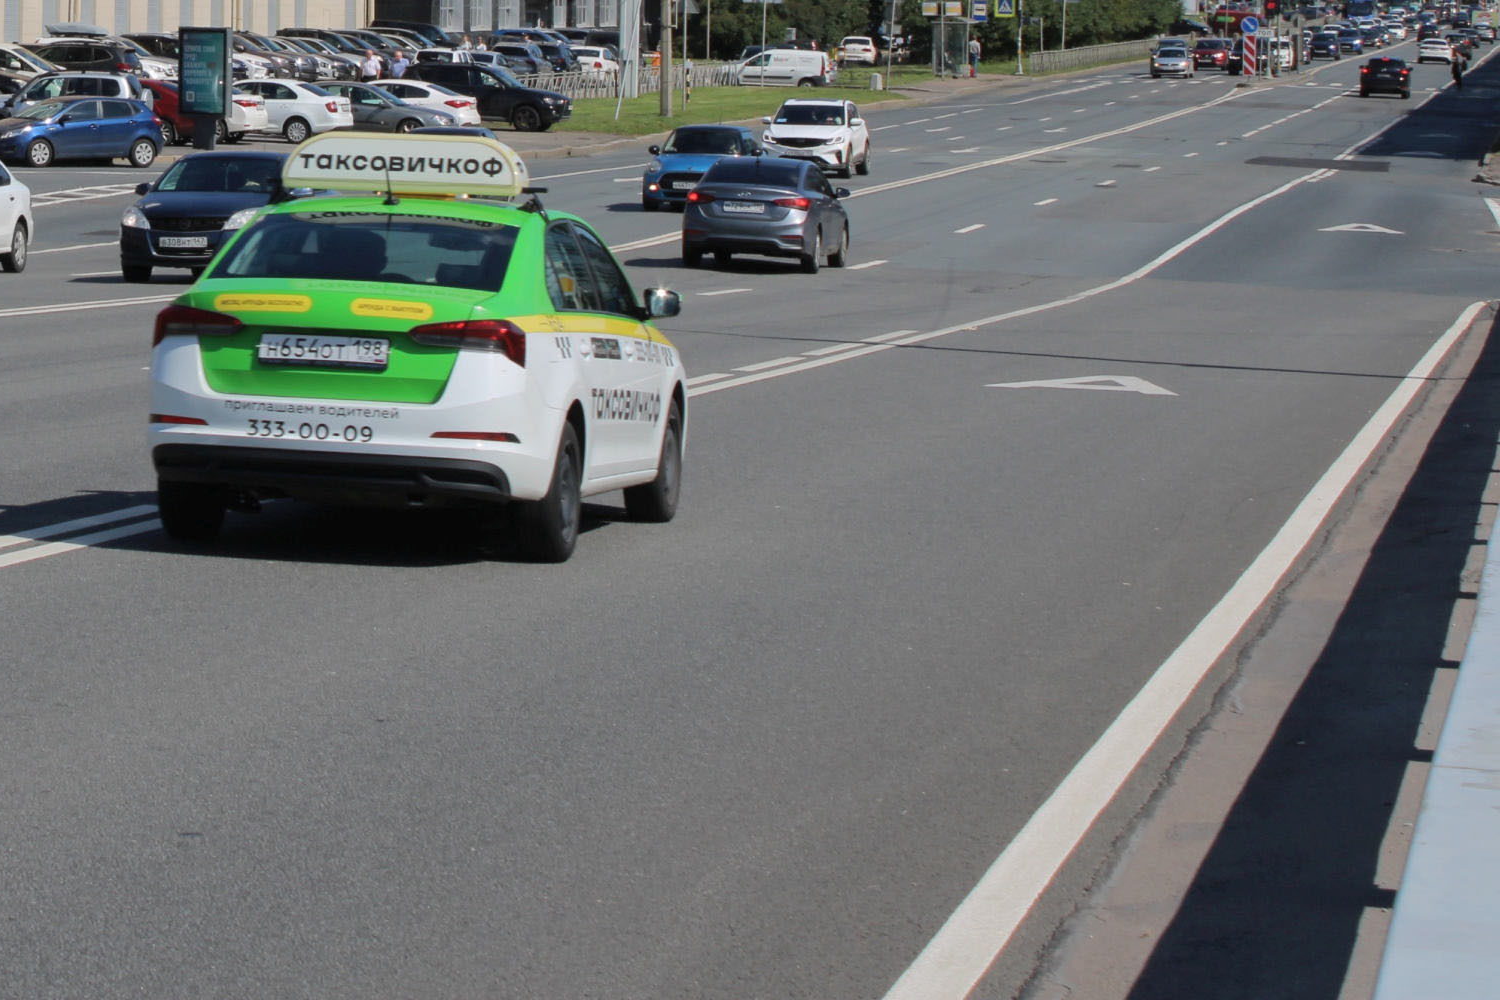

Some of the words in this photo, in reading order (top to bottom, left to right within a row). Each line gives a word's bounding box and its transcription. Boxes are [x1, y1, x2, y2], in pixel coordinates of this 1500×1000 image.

[225, 399, 314, 415] приглашаем
[319, 406, 399, 420] водителей
[247, 418, 373, 443] 333-00-09
